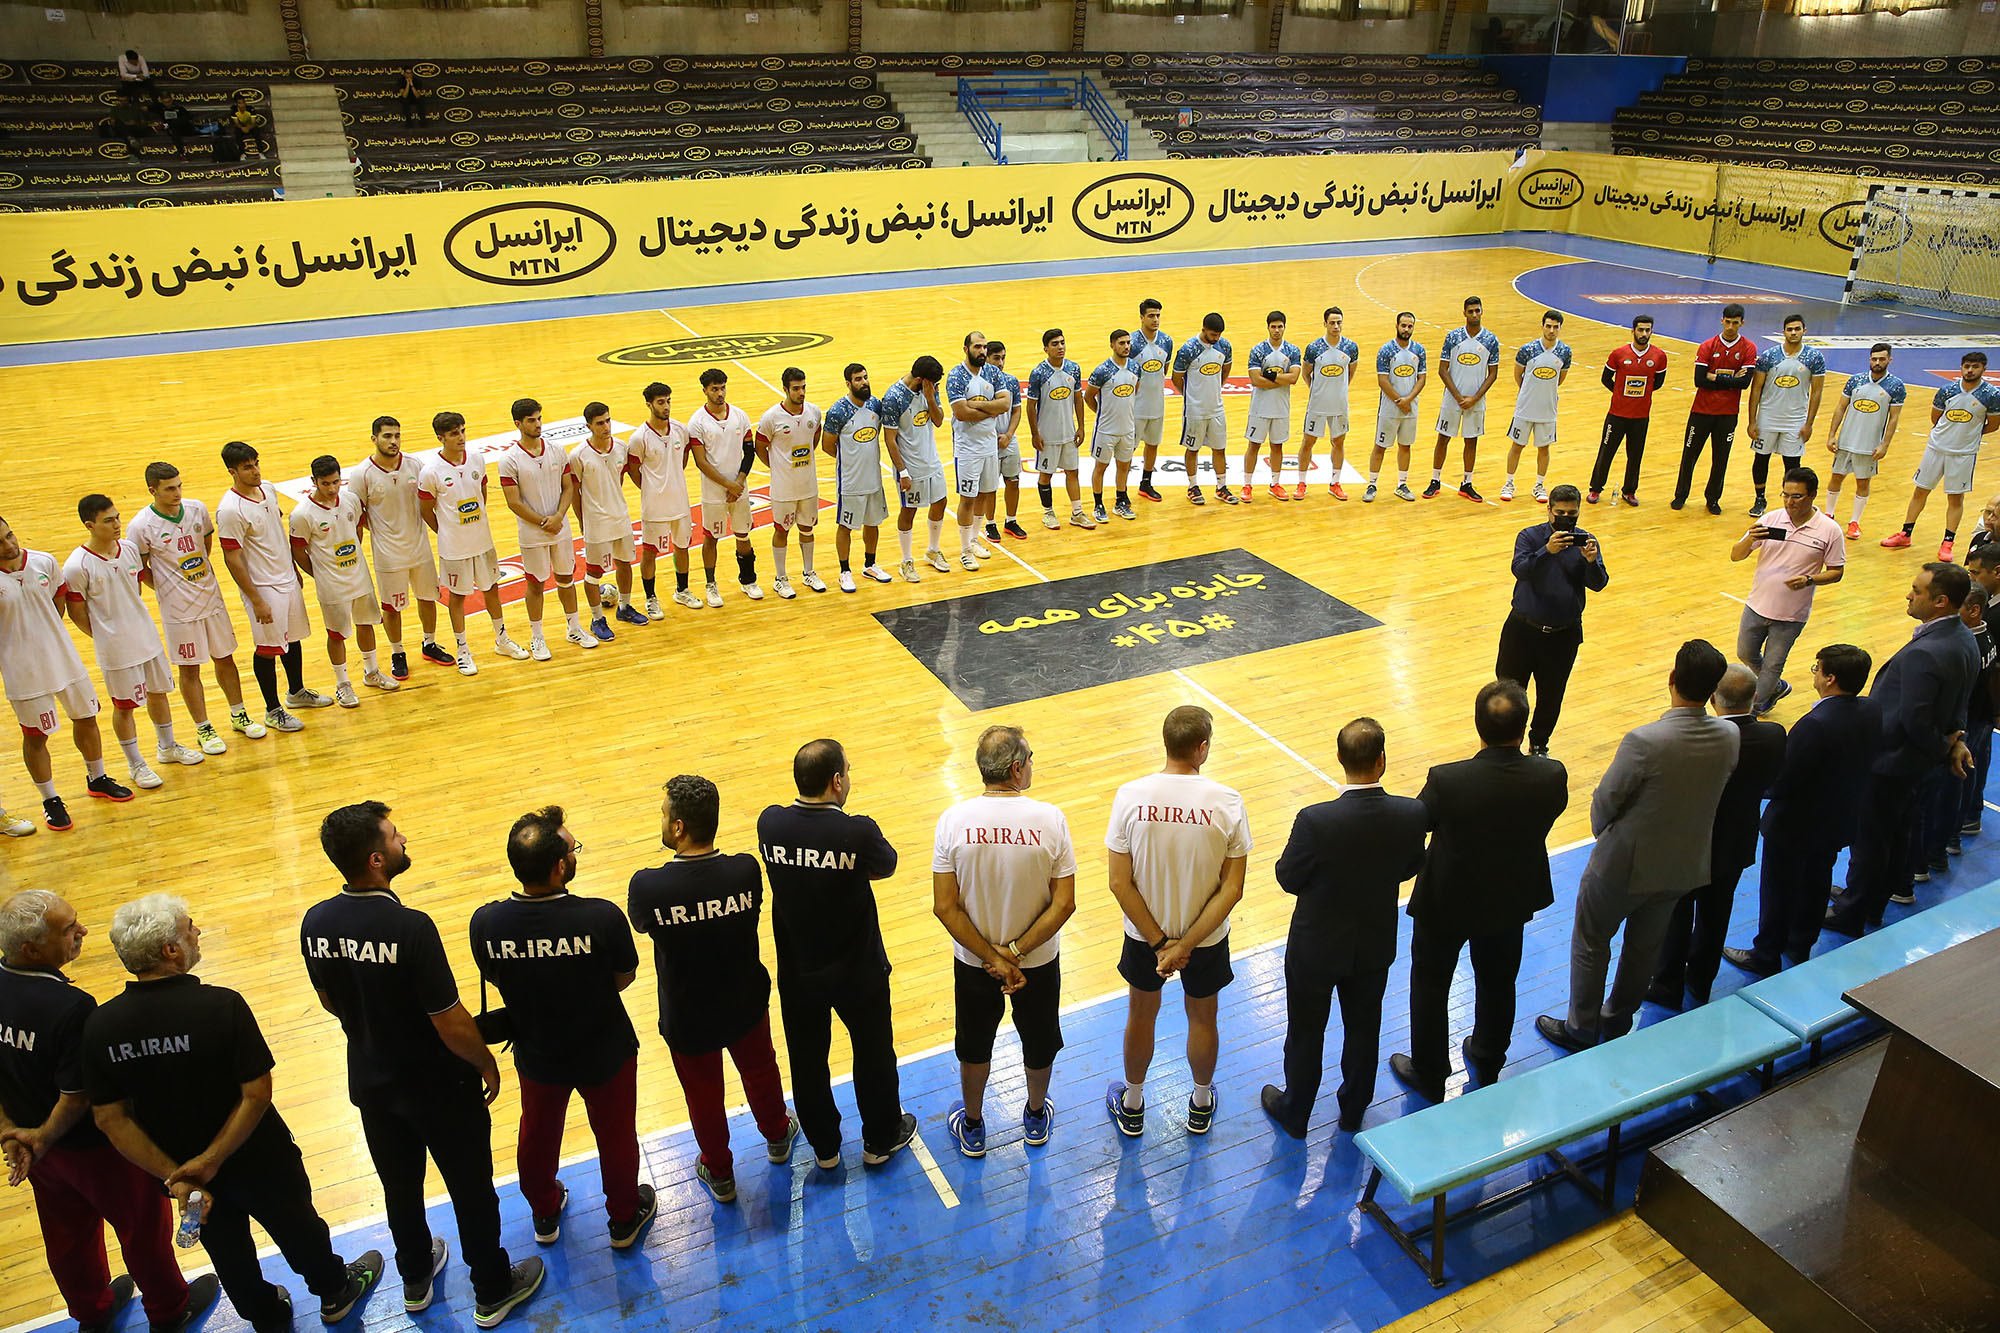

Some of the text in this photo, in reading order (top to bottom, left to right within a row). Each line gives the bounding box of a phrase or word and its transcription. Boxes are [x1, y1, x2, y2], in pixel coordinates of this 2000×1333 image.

[1528, 177, 1573, 195] ایرانسل
[1091, 186, 1171, 219] ایرانسل
[1209, 178, 1502, 222] ایرانسل؛ نبض زندگی دیجیتال
[1594, 185, 1649, 211] دیجیتال
[1650, 190, 1693, 219] زندگی
[1694, 197, 1733, 223] نبض
[640, 196, 1052, 257] ایرانسل؛ نبض زندگی دیجیتال
[1117, 221, 1154, 236] MTN
[473, 216, 582, 261] ایرانسل
[1846, 234, 1875, 248] MN
[17, 234, 416, 306] ایرانسل؛ نبض زندگی
[510, 259, 562, 277] MTN
[647, 336, 781, 357] ایرانسل
[696, 348, 759, 359] MTN
[1250, 426, 1256, 438] 7
[1309, 420, 1316, 432] 3
[1440, 420, 1449, 431] 14
[1512, 427, 1521, 439] 16
[1186, 434, 1196, 447] 20
[1379, 432, 1385, 443] 5
[1603, 424, 1612, 445] Kempa
[1686, 426, 1695, 448] Kempa
[793, 448, 810, 457] ایرانسل
[1042, 458, 1049, 470] 4
[961, 480, 974, 492] 27
[908, 492, 920, 504] 24
[460, 502, 479, 511] ایرانسل
[463, 514, 480, 524] MTN
[843, 511, 853, 524] 21
[713, 522, 724, 535] 51
[177, 535, 195, 553] 40
[336, 544, 356, 556] ایرانسل
[658, 536, 668, 550] 12
[181, 556, 204, 570] ایرانسل
[340, 558, 357, 568] MTN
[602, 552, 613, 568] 31
[448, 573, 458, 587] 17
[391, 593, 406, 607] 75
[978, 572, 1266, 634] جایزه برای همه
[178, 642, 196, 659] 40
[40, 710, 57, 731] 81
[1136, 804, 1213, 826] I.R.IRAN
[964, 826, 1042, 847] I.R.IRAN
[762, 843, 856, 871] I.R.IRAN
[653, 889, 754, 927] I.R.IRAN
[306, 935, 398, 965] I.R.IRAN
[486, 934, 592, 961] I.R.IRAN
[109, 1033, 191, 1063] I.R.IRAN
